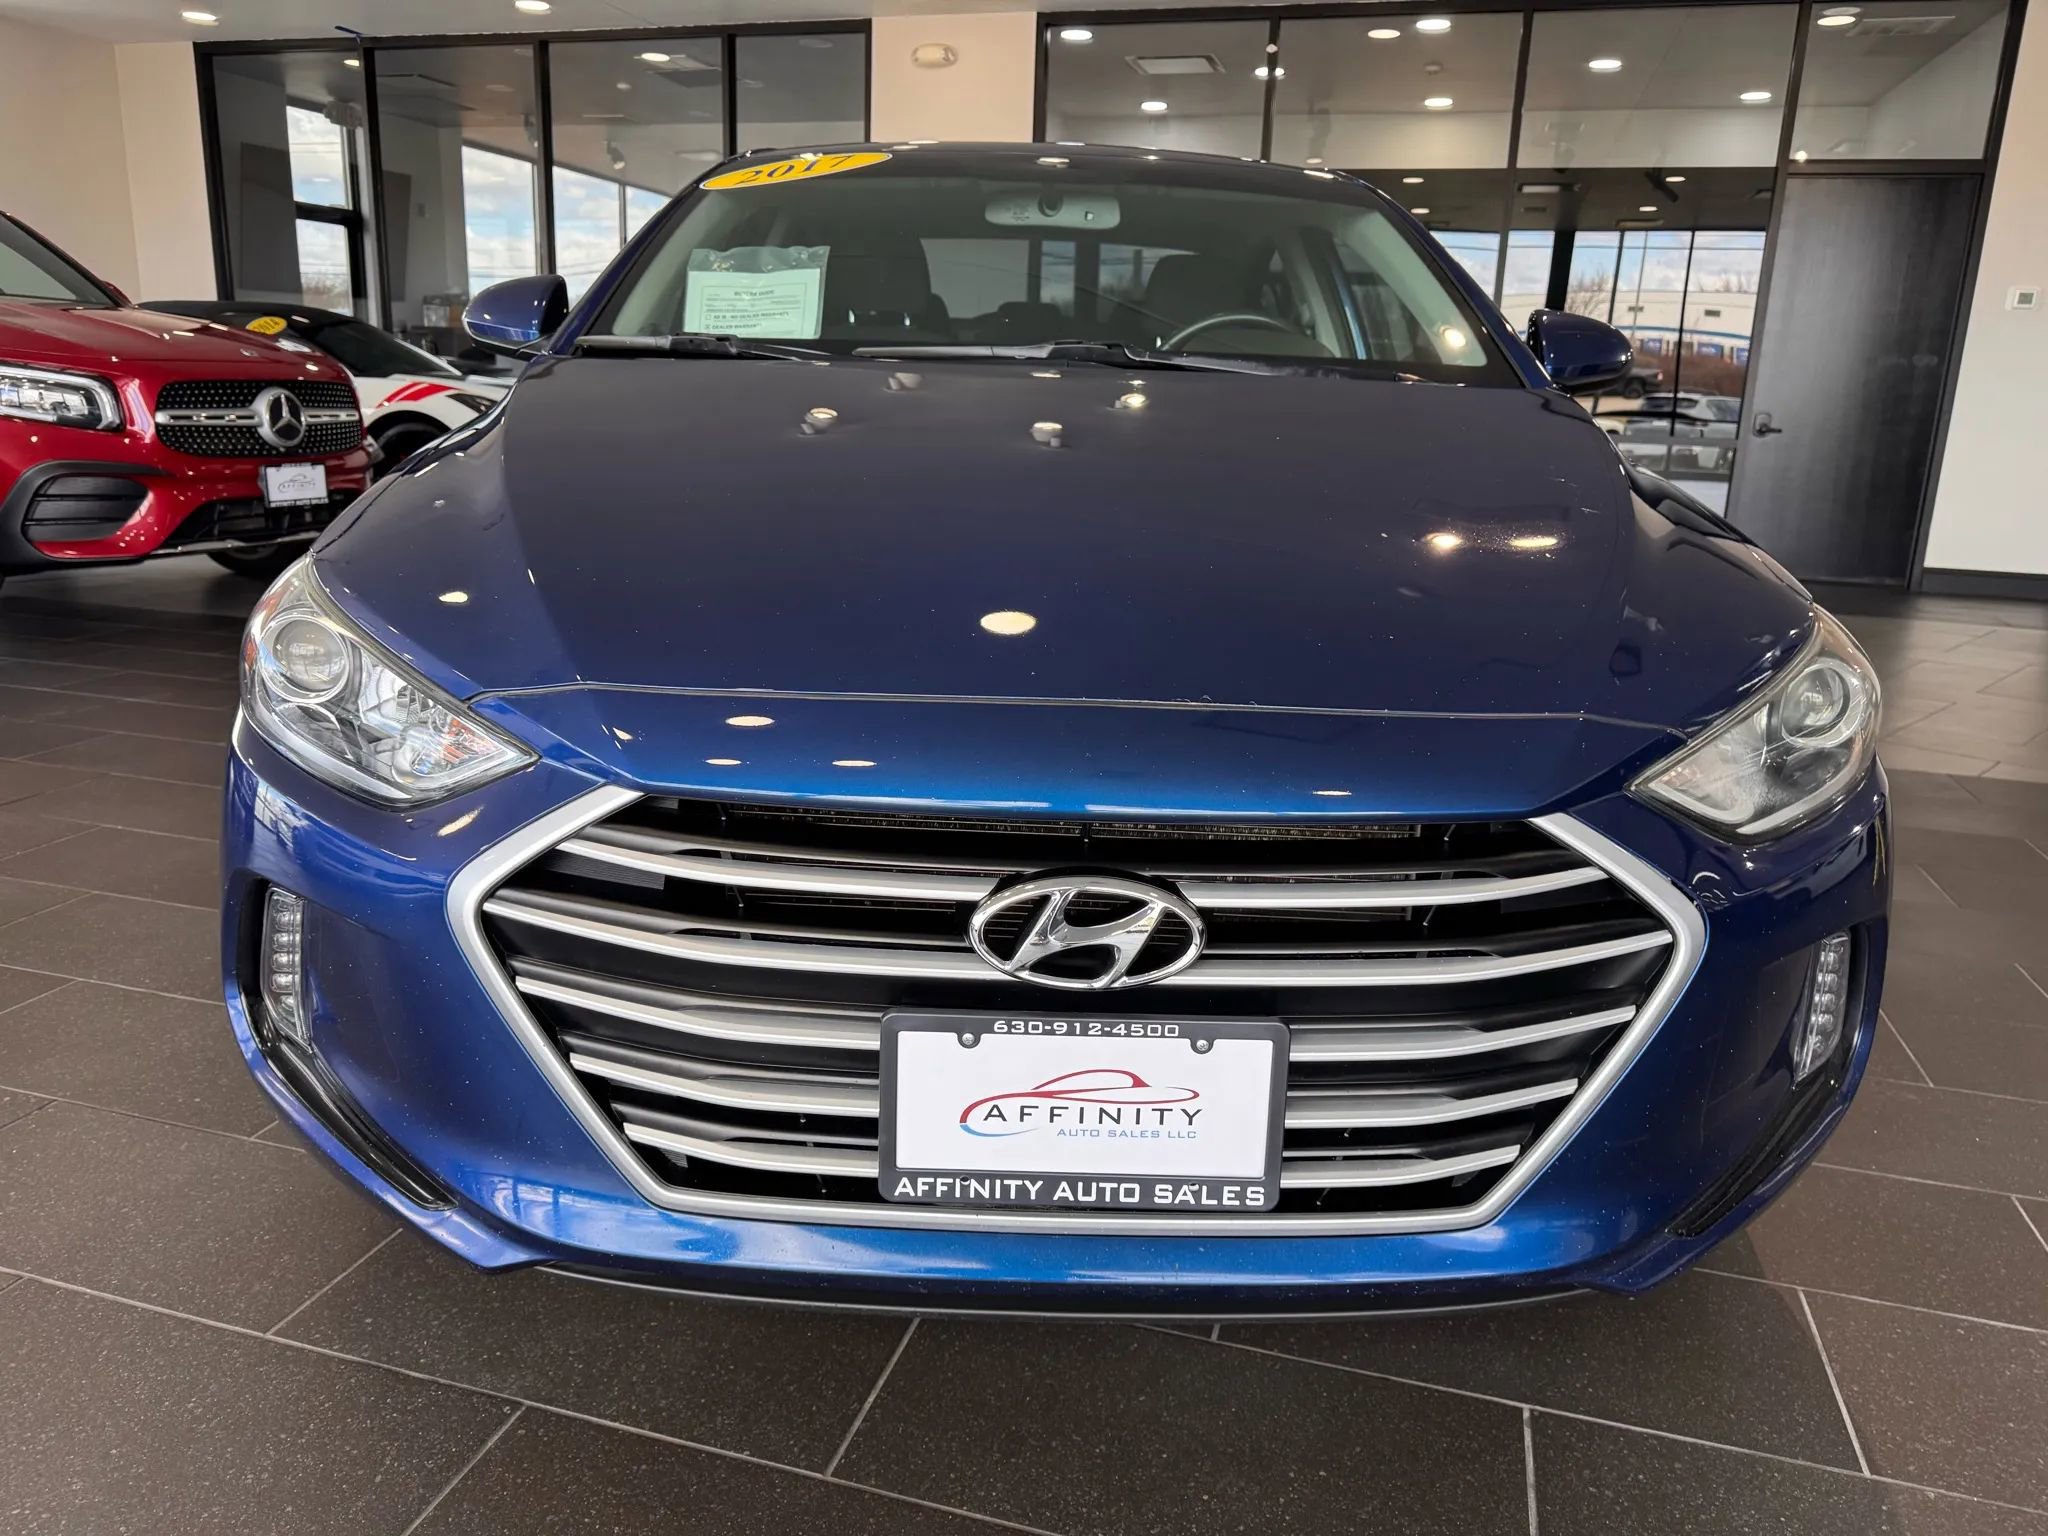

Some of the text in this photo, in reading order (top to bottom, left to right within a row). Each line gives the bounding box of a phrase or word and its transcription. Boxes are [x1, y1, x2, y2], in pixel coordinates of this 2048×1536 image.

[735, 154, 856, 185] 2017
[993, 1020, 1180, 1038] 630-912-4500
[983, 1104, 1203, 1126] AFFINITY
[1056, 1128, 1197, 1139] AUTO SALES LLC
[894, 1176, 1265, 1206] AFFINITY AUTO SALES
